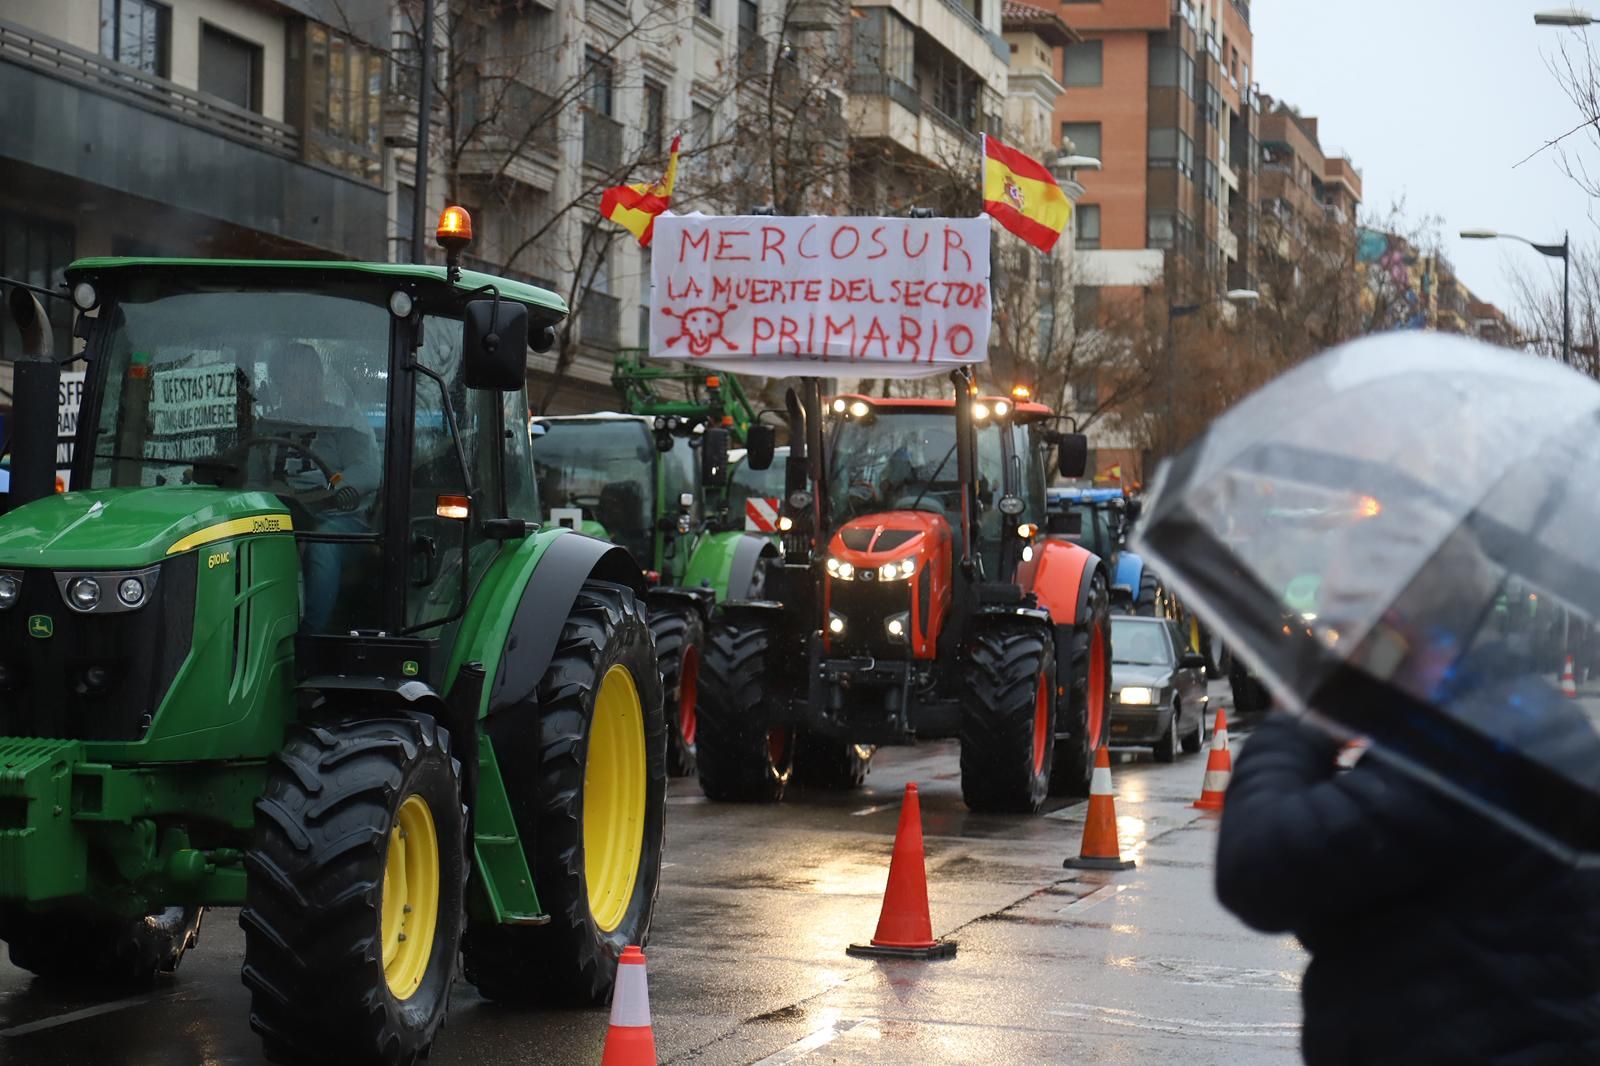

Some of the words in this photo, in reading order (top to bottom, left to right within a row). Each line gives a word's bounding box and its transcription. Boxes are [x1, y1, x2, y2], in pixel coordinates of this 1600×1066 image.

[679, 224, 972, 272] MERCOSUR
[667, 276, 703, 301] LA
[712, 276, 822, 304] MUERTE
[890, 280, 988, 310] SECTOR
[752, 313, 974, 363] PRIMARIO
[205, 371, 236, 398] PIZZ
[265, 518, 280, 530] DEERE
